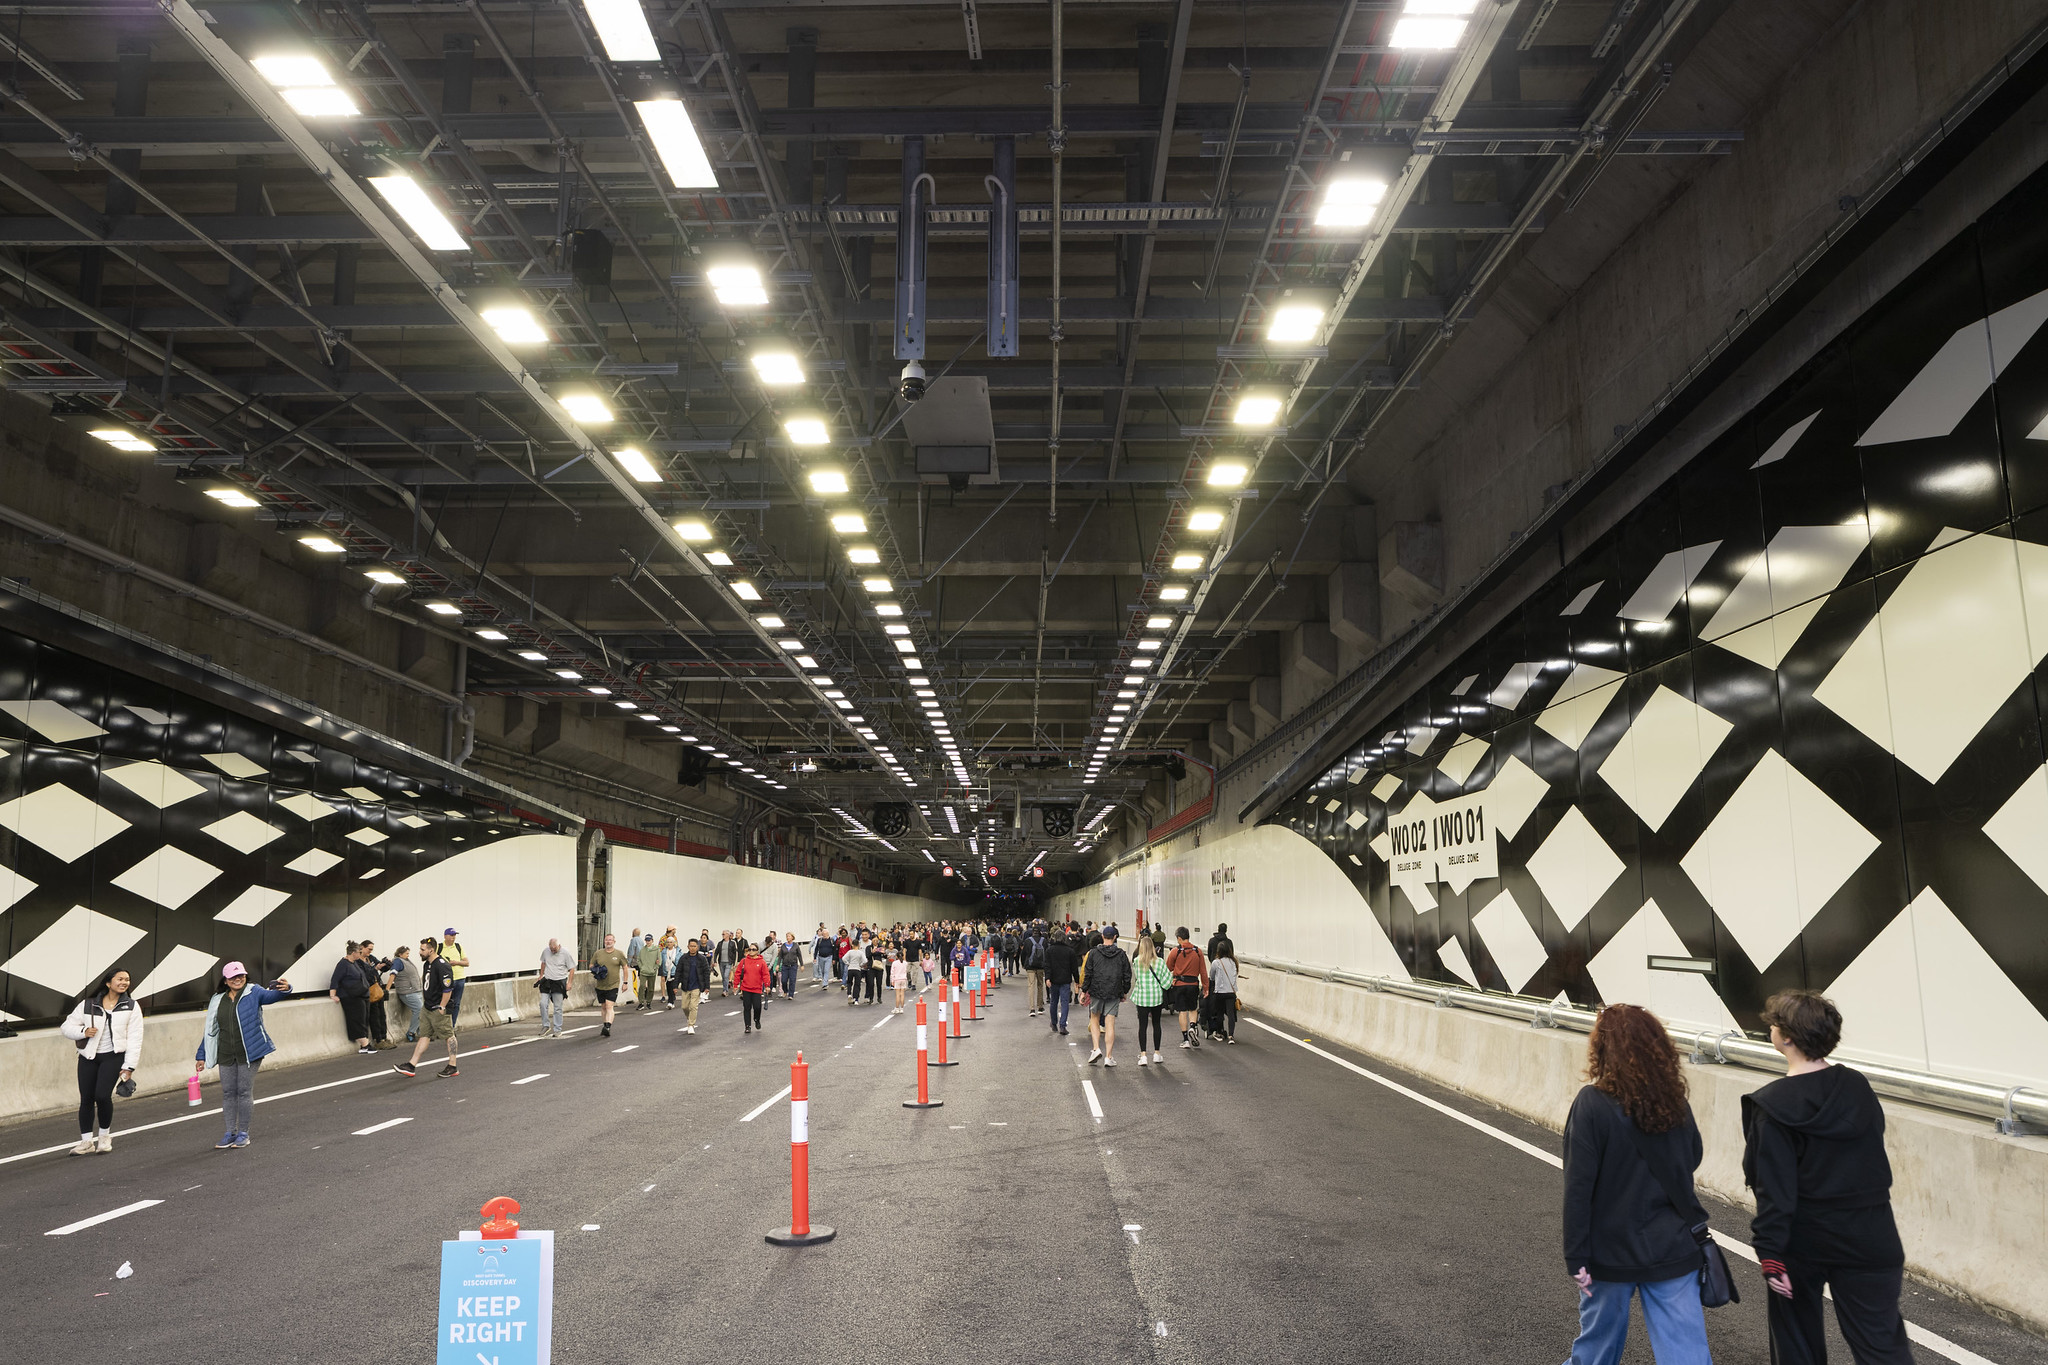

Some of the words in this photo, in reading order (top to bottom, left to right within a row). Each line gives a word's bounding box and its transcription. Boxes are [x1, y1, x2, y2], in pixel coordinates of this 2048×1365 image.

[1466, 805, 1484, 843] 01
[1411, 820, 1426, 852] 02
[1412, 861, 1422, 870] ZONE
[1448, 855, 1465, 865] DELUGE
[1467, 852, 1479, 863] ZONE
[463, 1279, 503, 1287] DISCOVERY
[503, 1278, 517, 1286] DAY
[457, 1295, 521, 1317] KEEP
[449, 1321, 527, 1344] RIGHT
